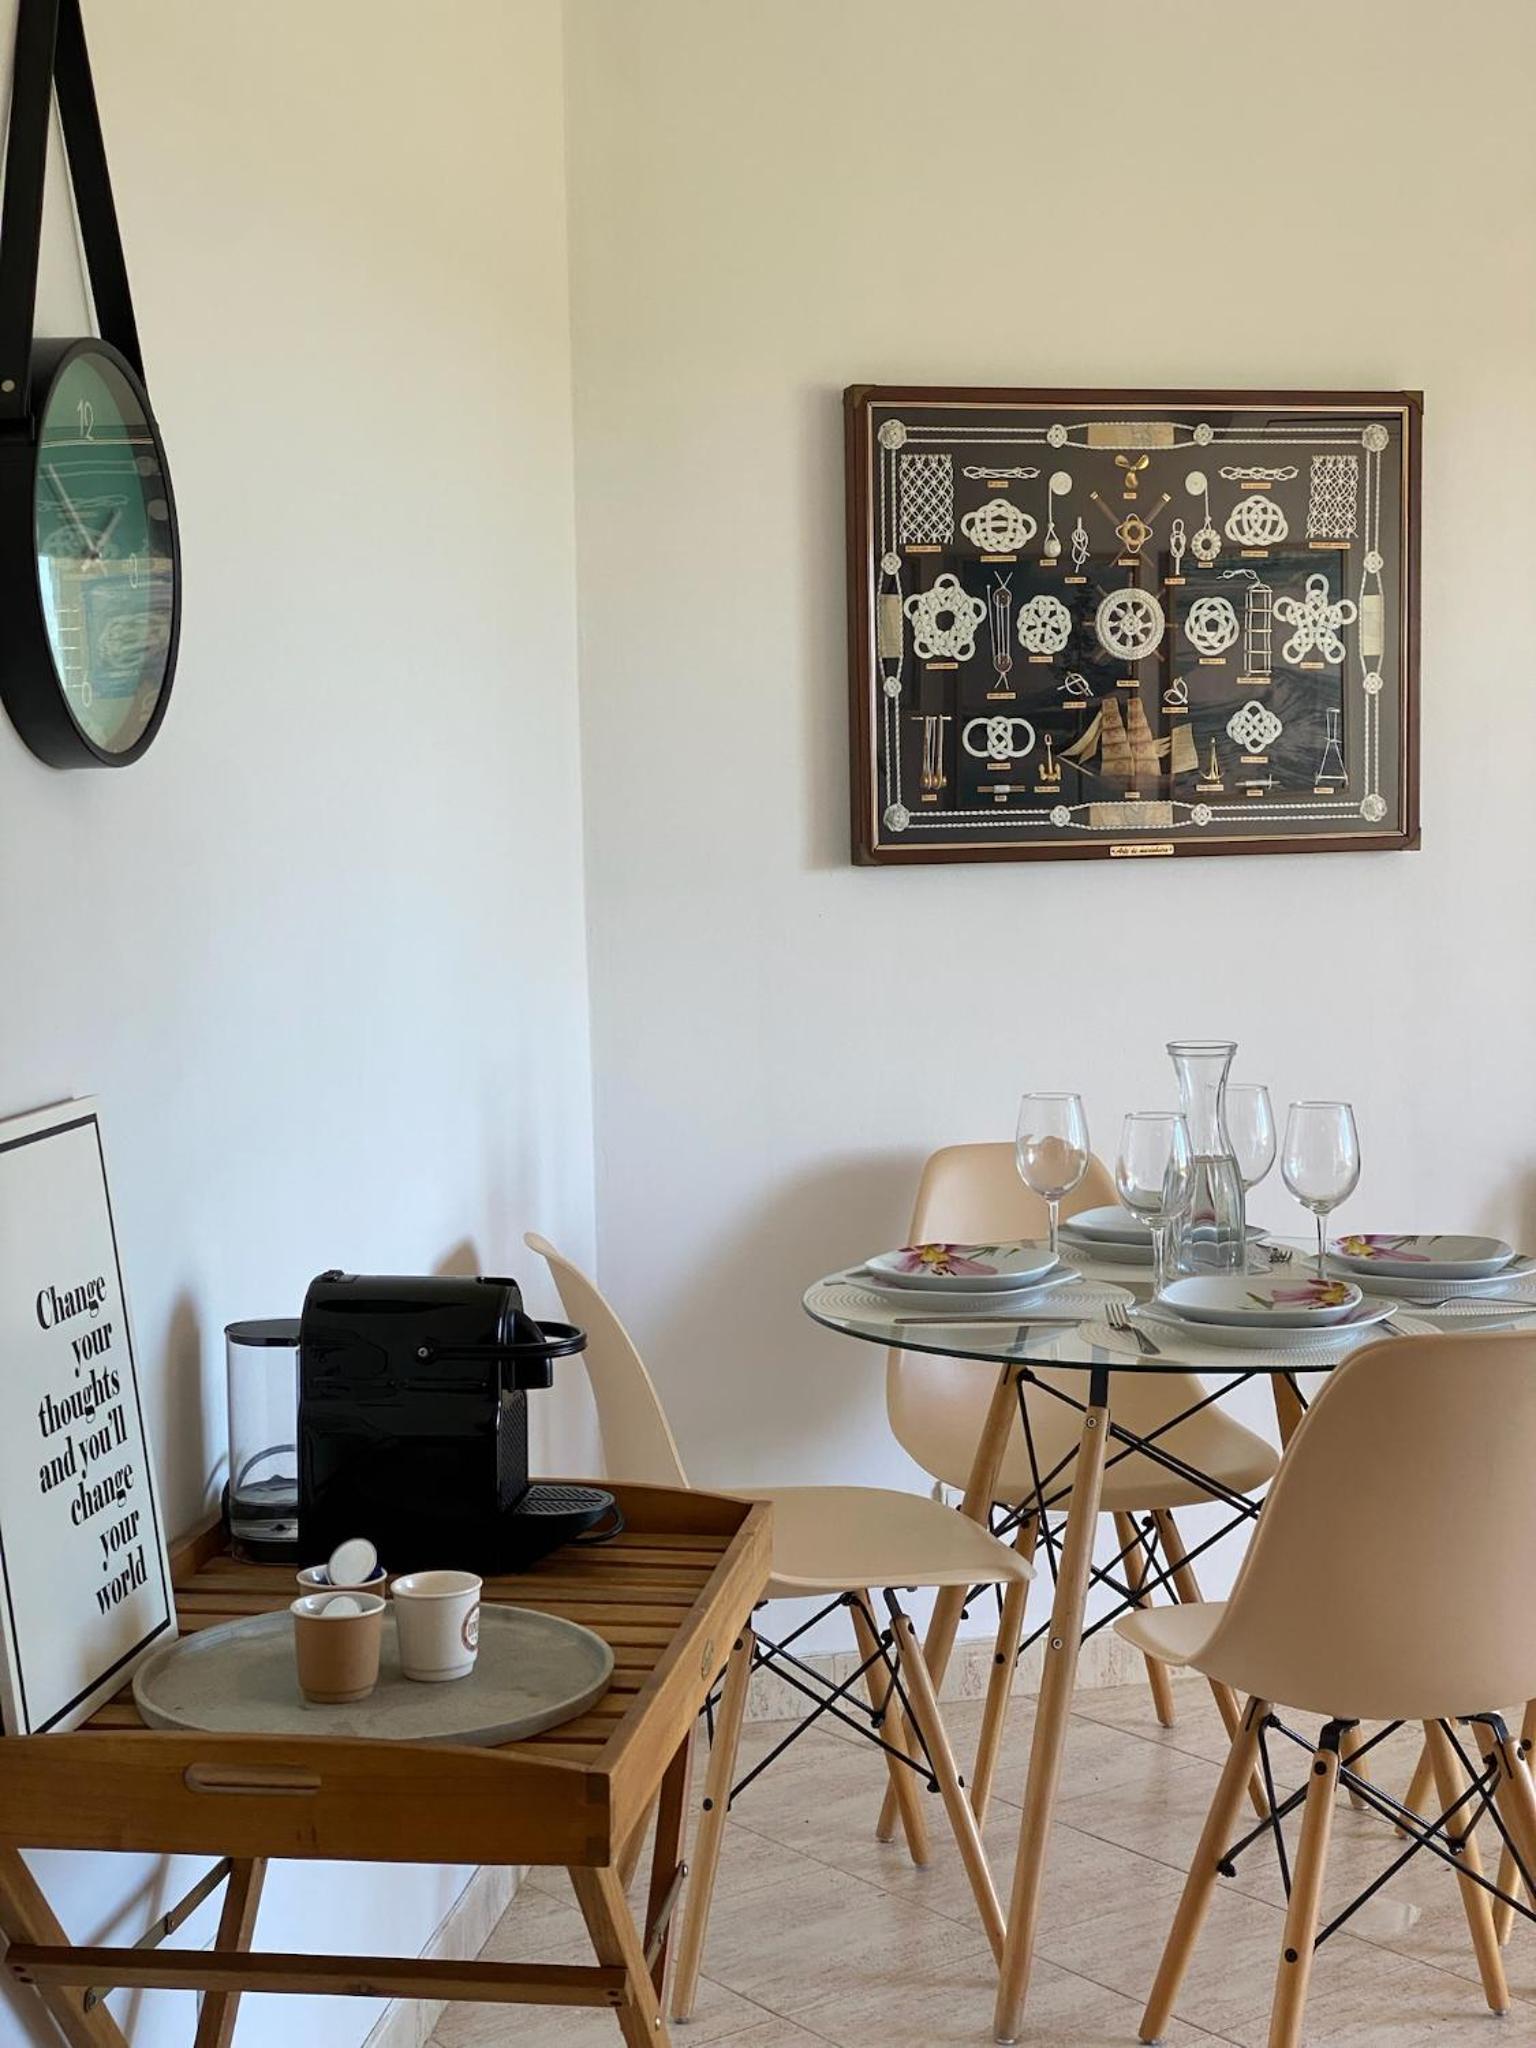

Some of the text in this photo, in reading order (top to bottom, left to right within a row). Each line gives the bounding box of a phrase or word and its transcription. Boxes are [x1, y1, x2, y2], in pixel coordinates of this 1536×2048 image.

[77, 399, 95, 441] 12
[36, 1274, 106, 1330] Change
[71, 1322, 113, 1378] your
[38, 1367, 121, 1438] thoughts
[39, 1404, 128, 1494] and you'll
[70, 1462, 133, 1527] change
[99, 1509, 140, 1572] your
[96, 1544, 148, 1616] world
